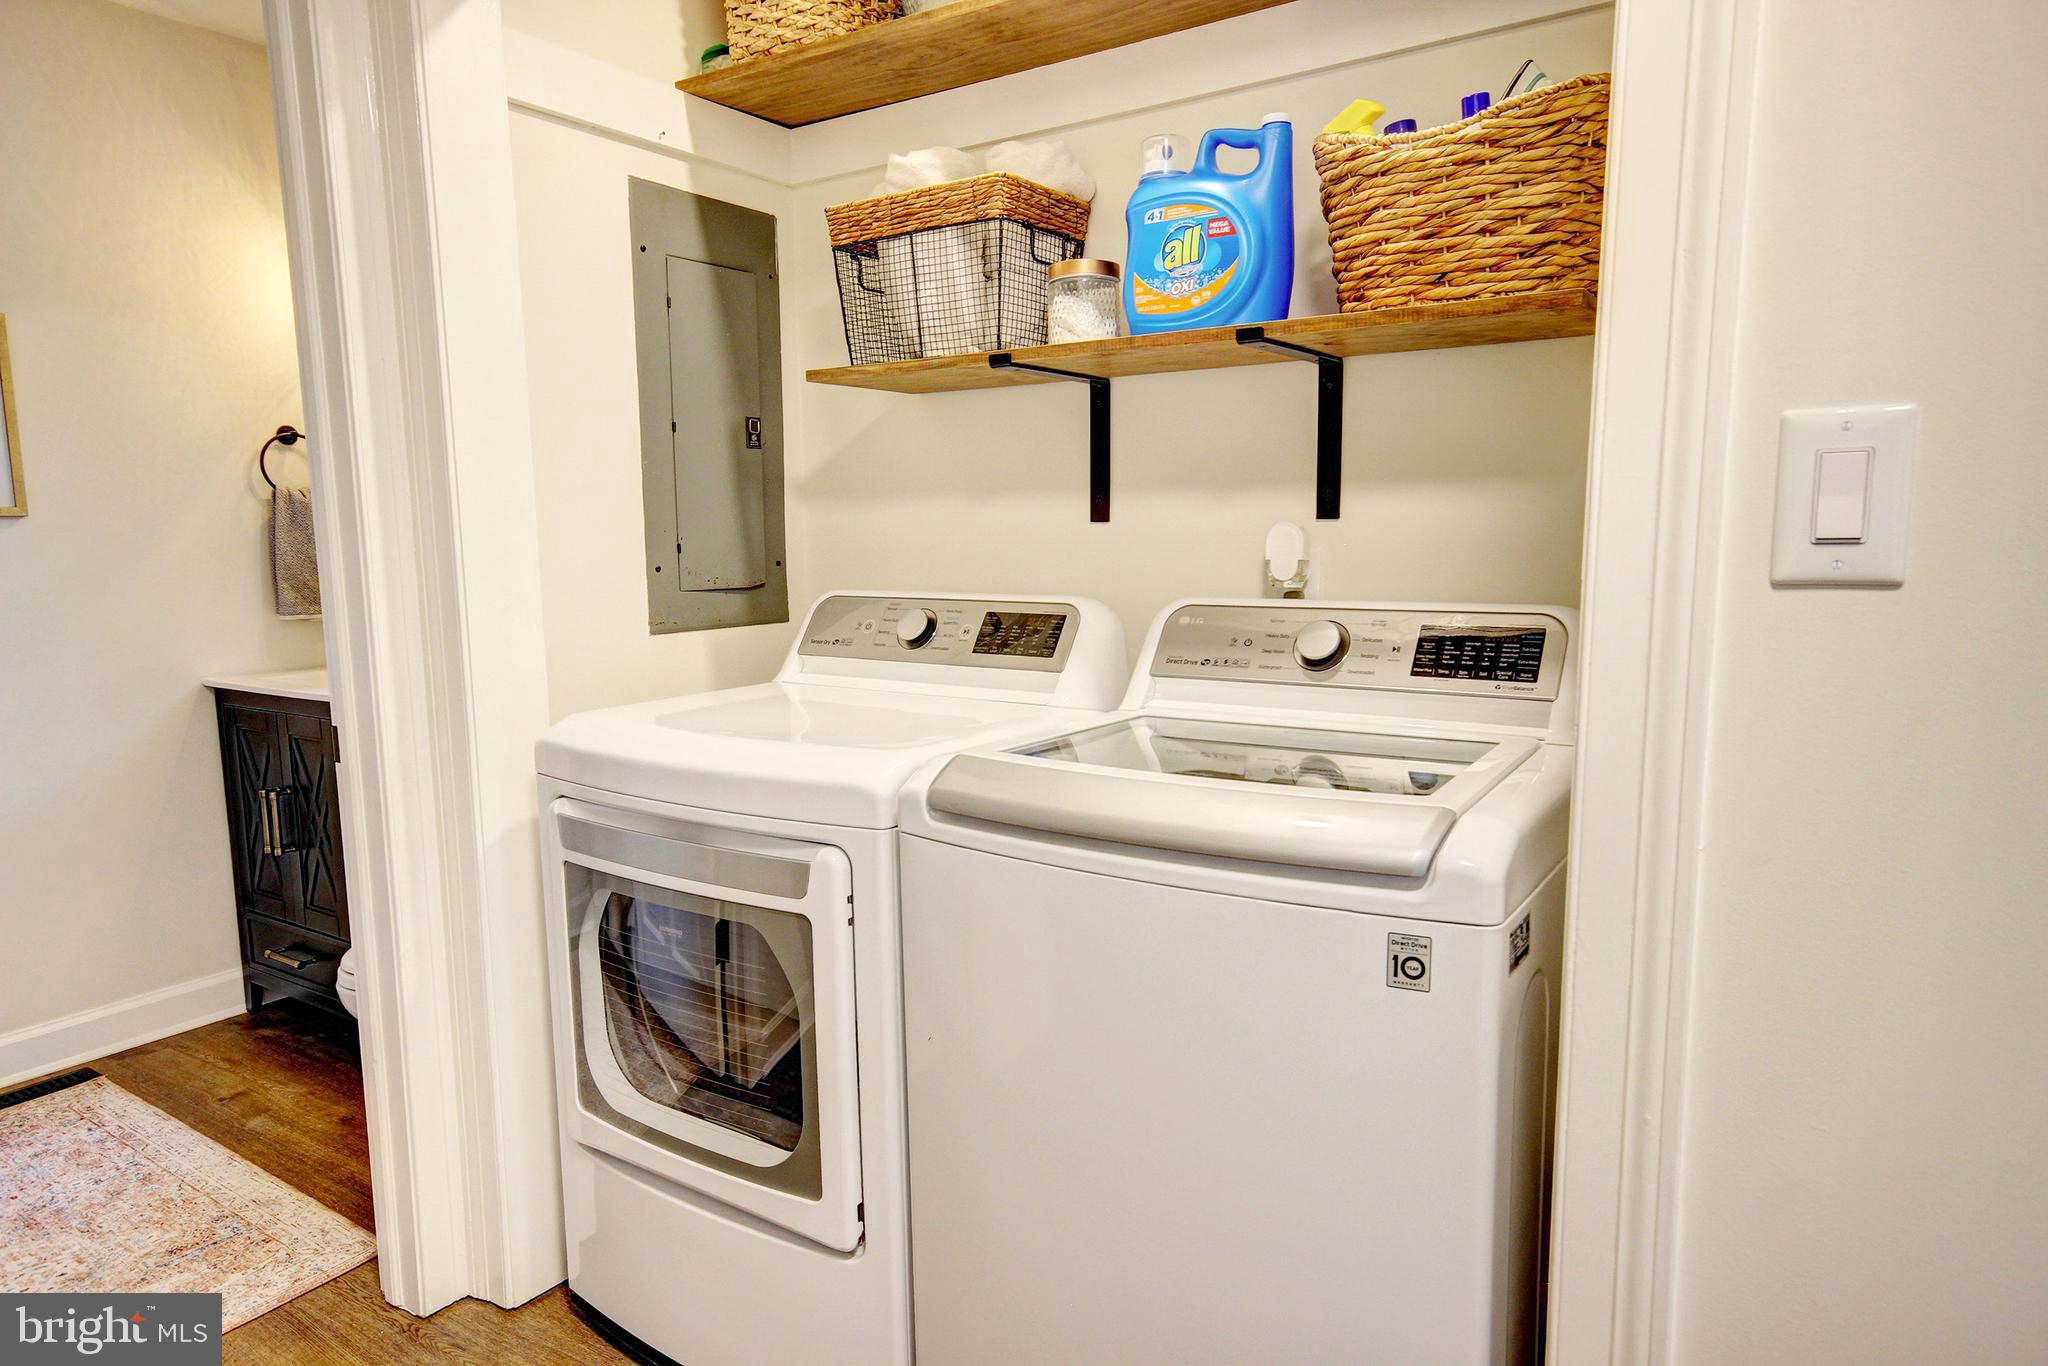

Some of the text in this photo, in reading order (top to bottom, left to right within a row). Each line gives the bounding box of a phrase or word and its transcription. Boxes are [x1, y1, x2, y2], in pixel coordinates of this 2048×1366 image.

[1164, 224, 1201, 270] all
[1171, 279, 1195, 295] OXI
[1166, 657, 1199, 666] Direct Drive
[1391, 939, 1428, 949] Direct Drive
[1391, 954, 1426, 980] 10
